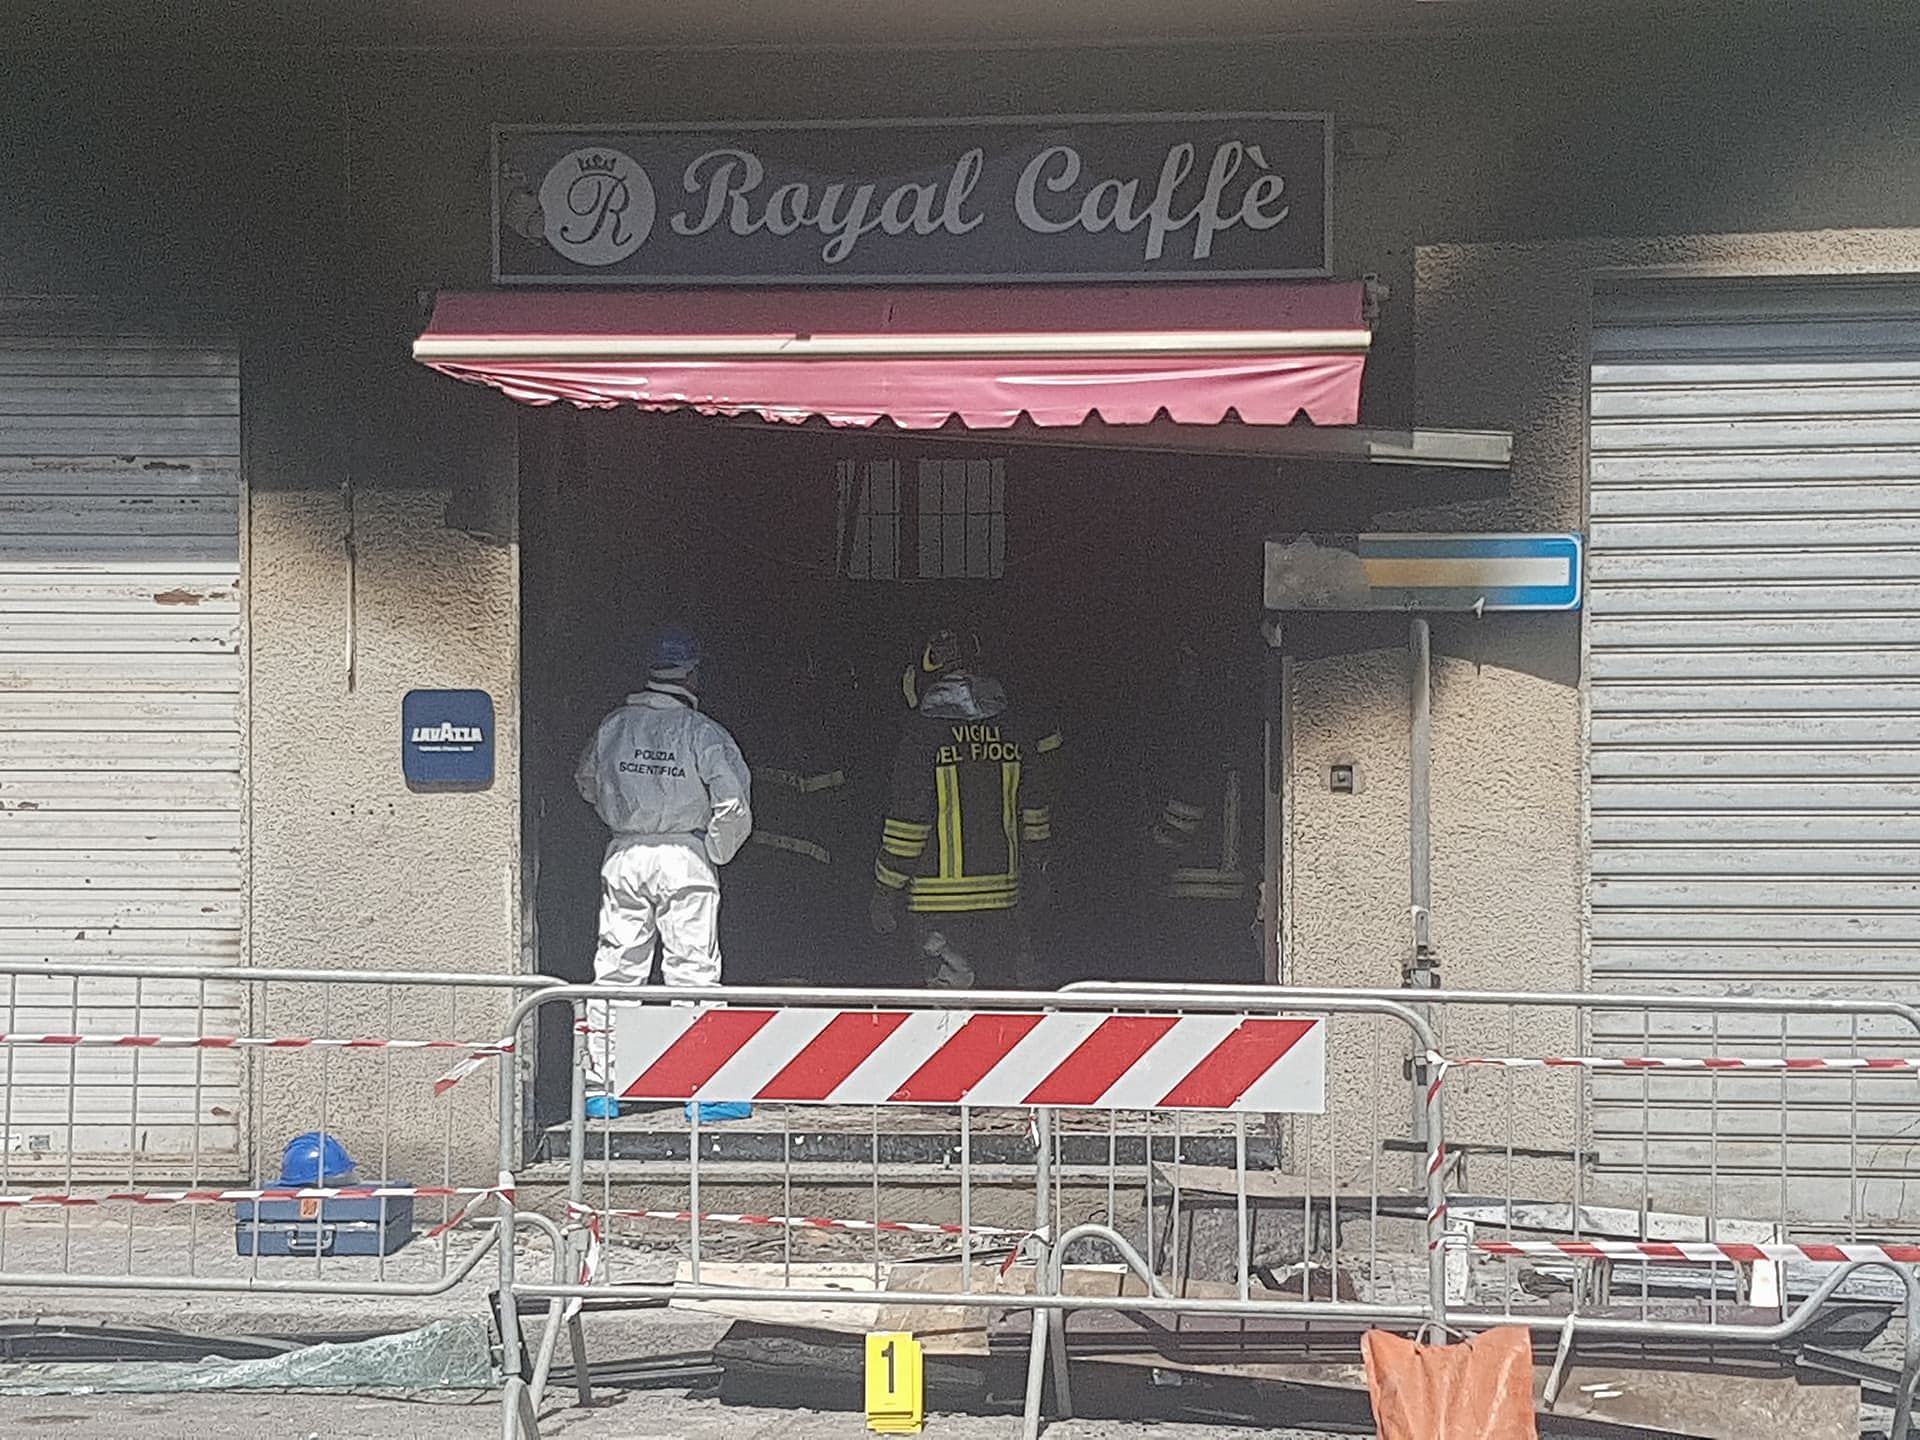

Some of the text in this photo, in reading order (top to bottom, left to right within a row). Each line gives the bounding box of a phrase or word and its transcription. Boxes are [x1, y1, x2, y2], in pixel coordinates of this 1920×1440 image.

[671, 140, 1290, 263] Royal Caffè
[412, 722, 483, 742] LAVAZZA
[951, 725, 1001, 742] VIGILI
[634, 748, 676, 761] POLIZIA
[936, 745, 962, 763] EL
[619, 761, 686, 778] SCIENTIFICA
[881, 1341, 894, 1393] 1
